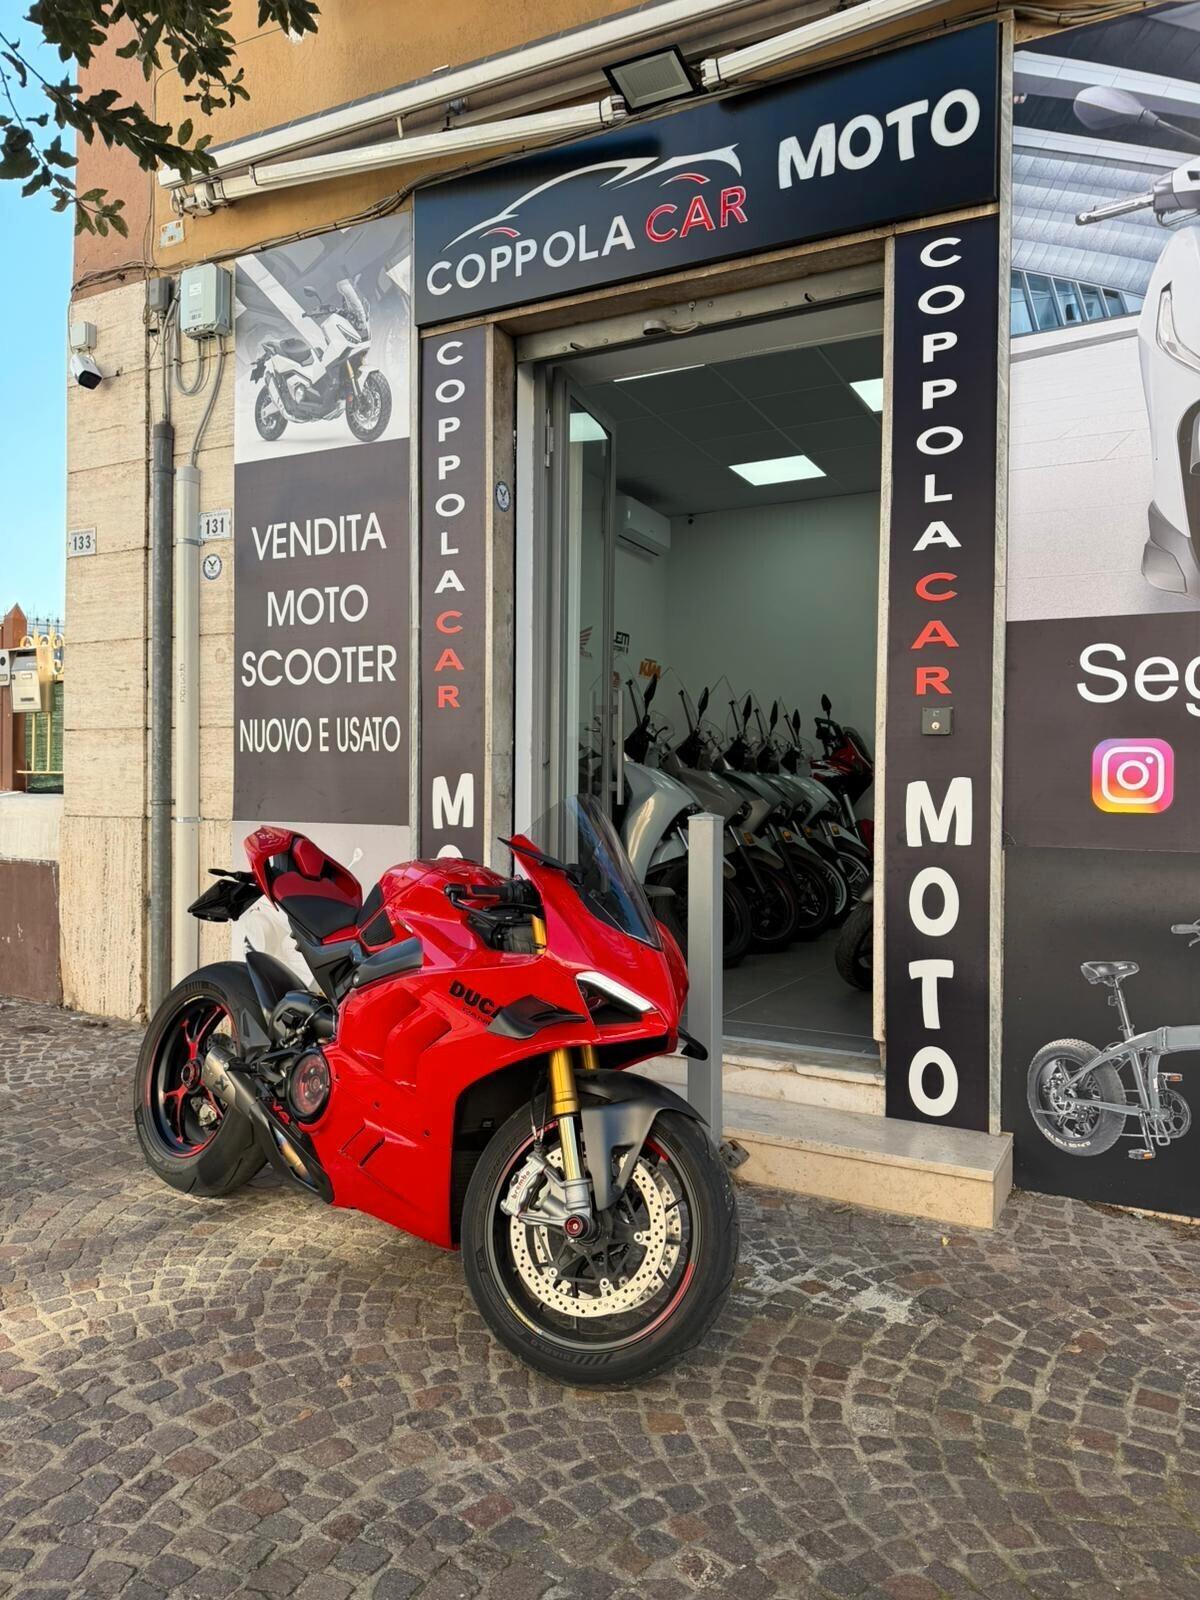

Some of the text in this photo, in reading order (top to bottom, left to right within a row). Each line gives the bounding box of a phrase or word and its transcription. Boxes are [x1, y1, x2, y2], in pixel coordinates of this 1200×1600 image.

[777, 88, 980, 190] MOTO
[426, 185, 749, 296] COPPOLA CAR
[434, 341, 466, 593] COPPOLA
[73, 535, 91, 551] 133
[206, 517, 224, 534] 131
[251, 512, 387, 561] VENDITA
[267, 584, 369, 627] MOTO
[241, 644, 397, 687] SCOOTER
[434, 610, 465, 708] CAR
[906, 237, 973, 1117] COPPOLA CAR MOTO
[240, 716, 401, 753] NUOVO E USATO
[511, 1169, 531, 1200] brembo
